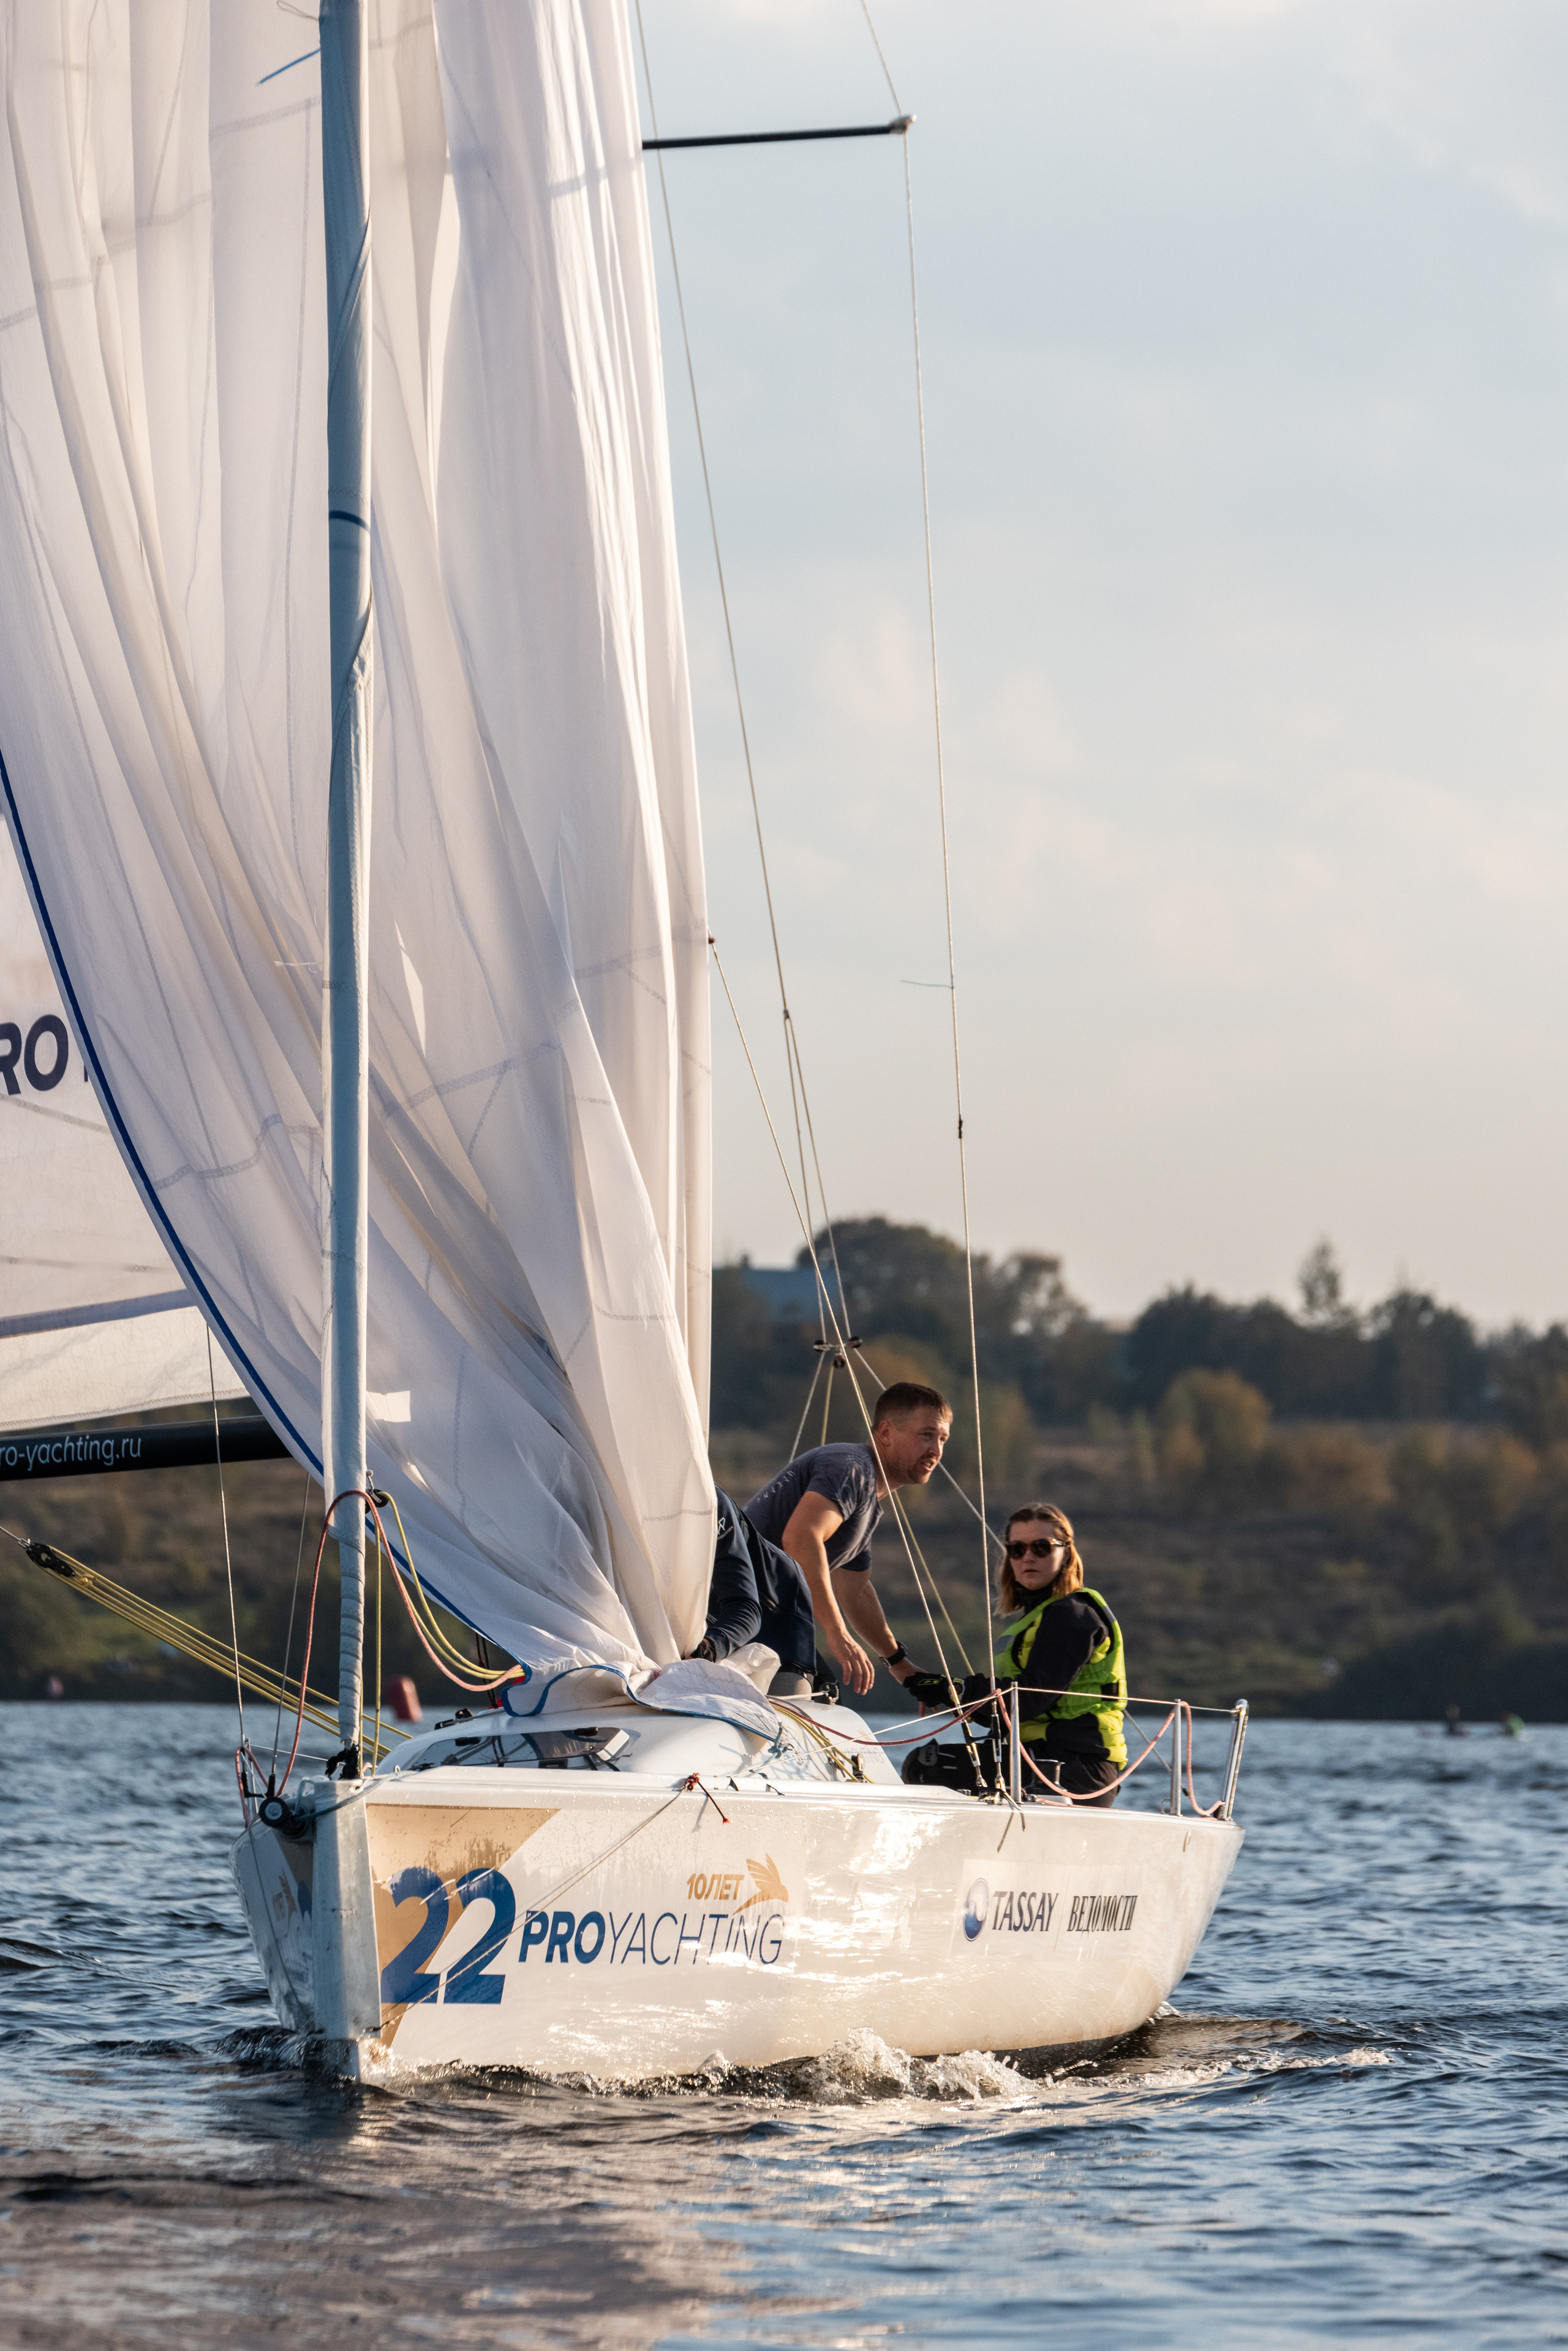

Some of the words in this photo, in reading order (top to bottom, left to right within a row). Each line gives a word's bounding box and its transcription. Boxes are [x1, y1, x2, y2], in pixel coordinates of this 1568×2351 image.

[0, 1014, 88, 1095] RO
[381, 1866, 516, 2004] 22
[518, 1911, 785, 1965] PROYACHTING
[992, 1890, 1060, 1932] TASSAY
